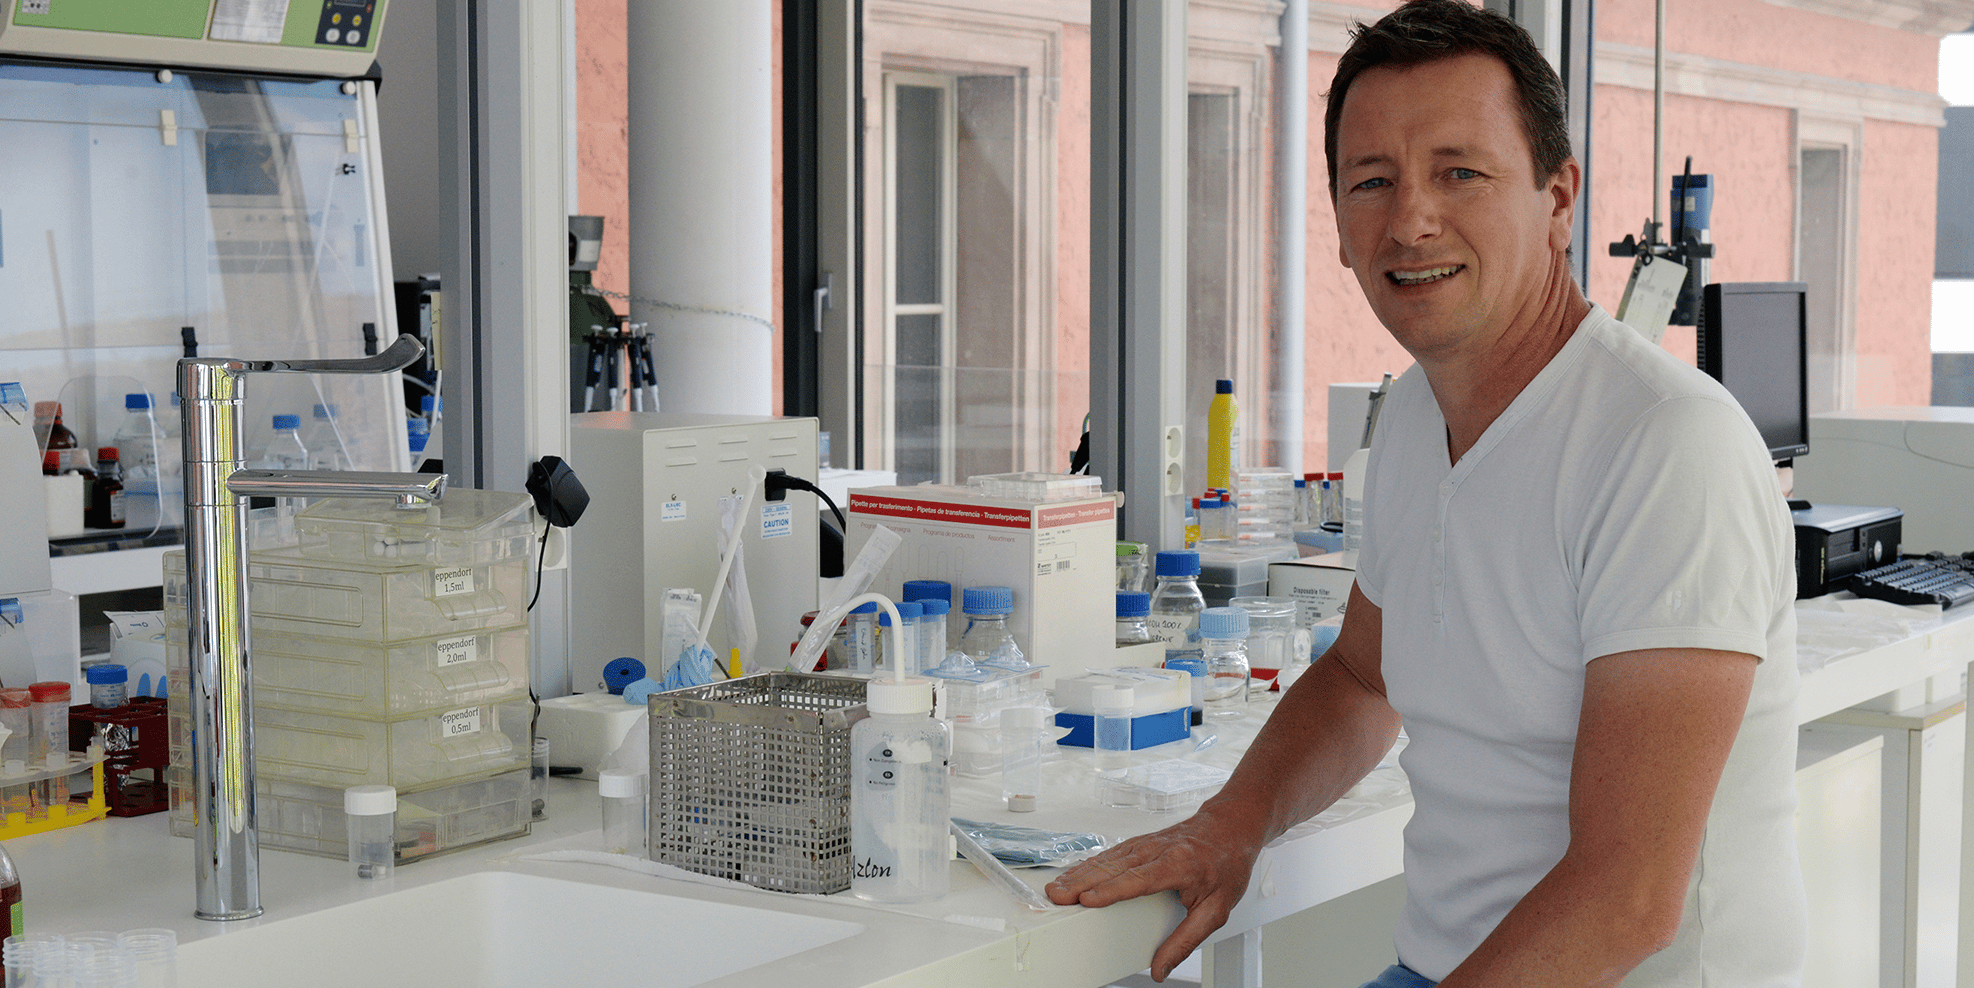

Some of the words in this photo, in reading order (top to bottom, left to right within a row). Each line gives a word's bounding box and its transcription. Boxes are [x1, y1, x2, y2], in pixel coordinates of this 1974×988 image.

[850, 499, 868, 507] Pipette
[878, 502, 913, 511] trasferimento
[917, 505, 936, 514] Pipetas
[945, 508, 980, 518] transferencia
[984, 511, 1030, 522] Transferpipetten
[763, 518, 789, 528] CAUTION
[435, 567, 472, 582] eppendorf
[444, 580, 464, 593] 1,5ml
[437, 636, 475, 653] eppendorf
[442, 706, 479, 723] eppendorf
[451, 721, 471, 734] 0,5ml
